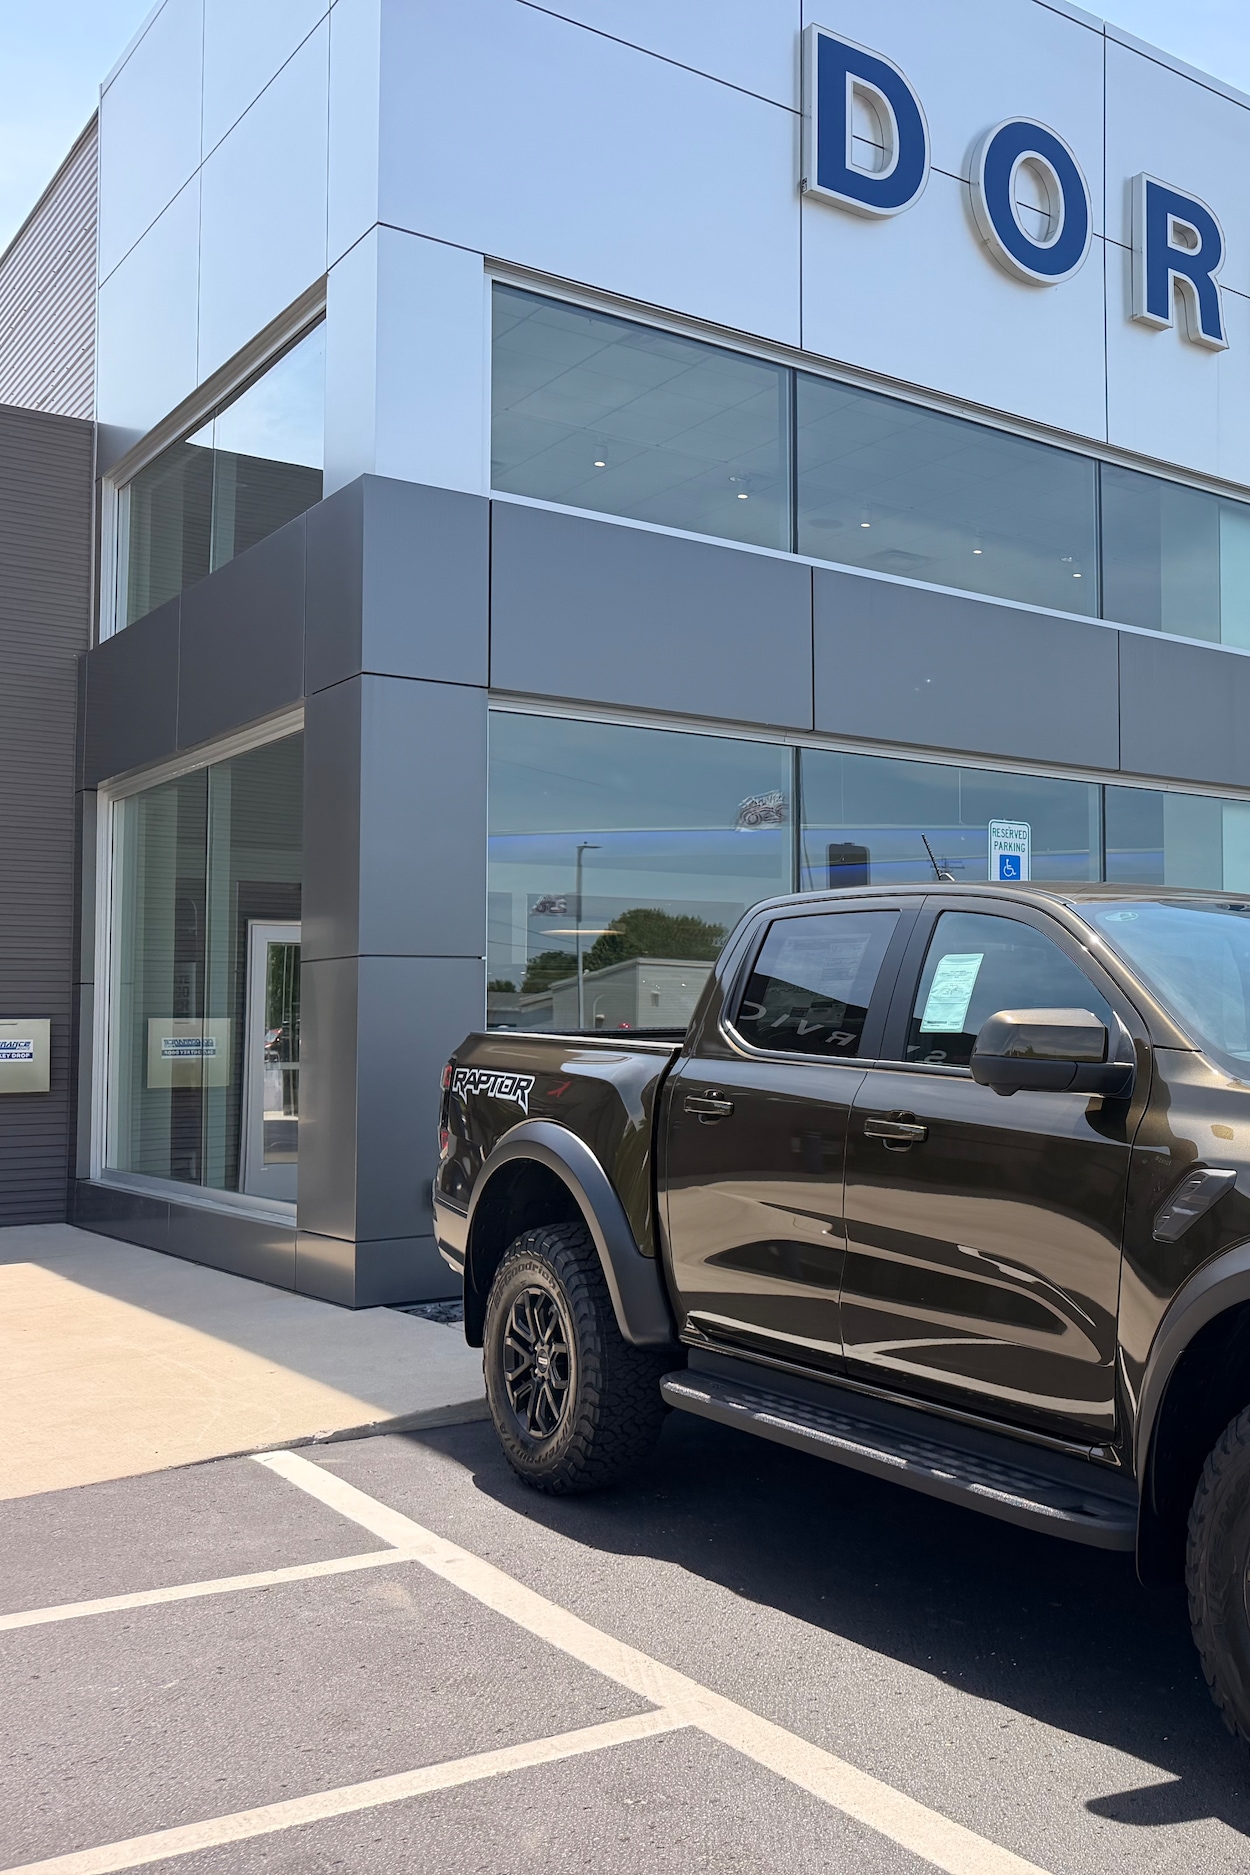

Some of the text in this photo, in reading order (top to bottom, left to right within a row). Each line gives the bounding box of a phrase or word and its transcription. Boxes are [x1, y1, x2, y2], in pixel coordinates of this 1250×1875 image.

[992, 827, 1028, 840] RESERVED
[994, 841, 1026, 853] PARKING
[451, 1067, 536, 1115] RAPTOR
